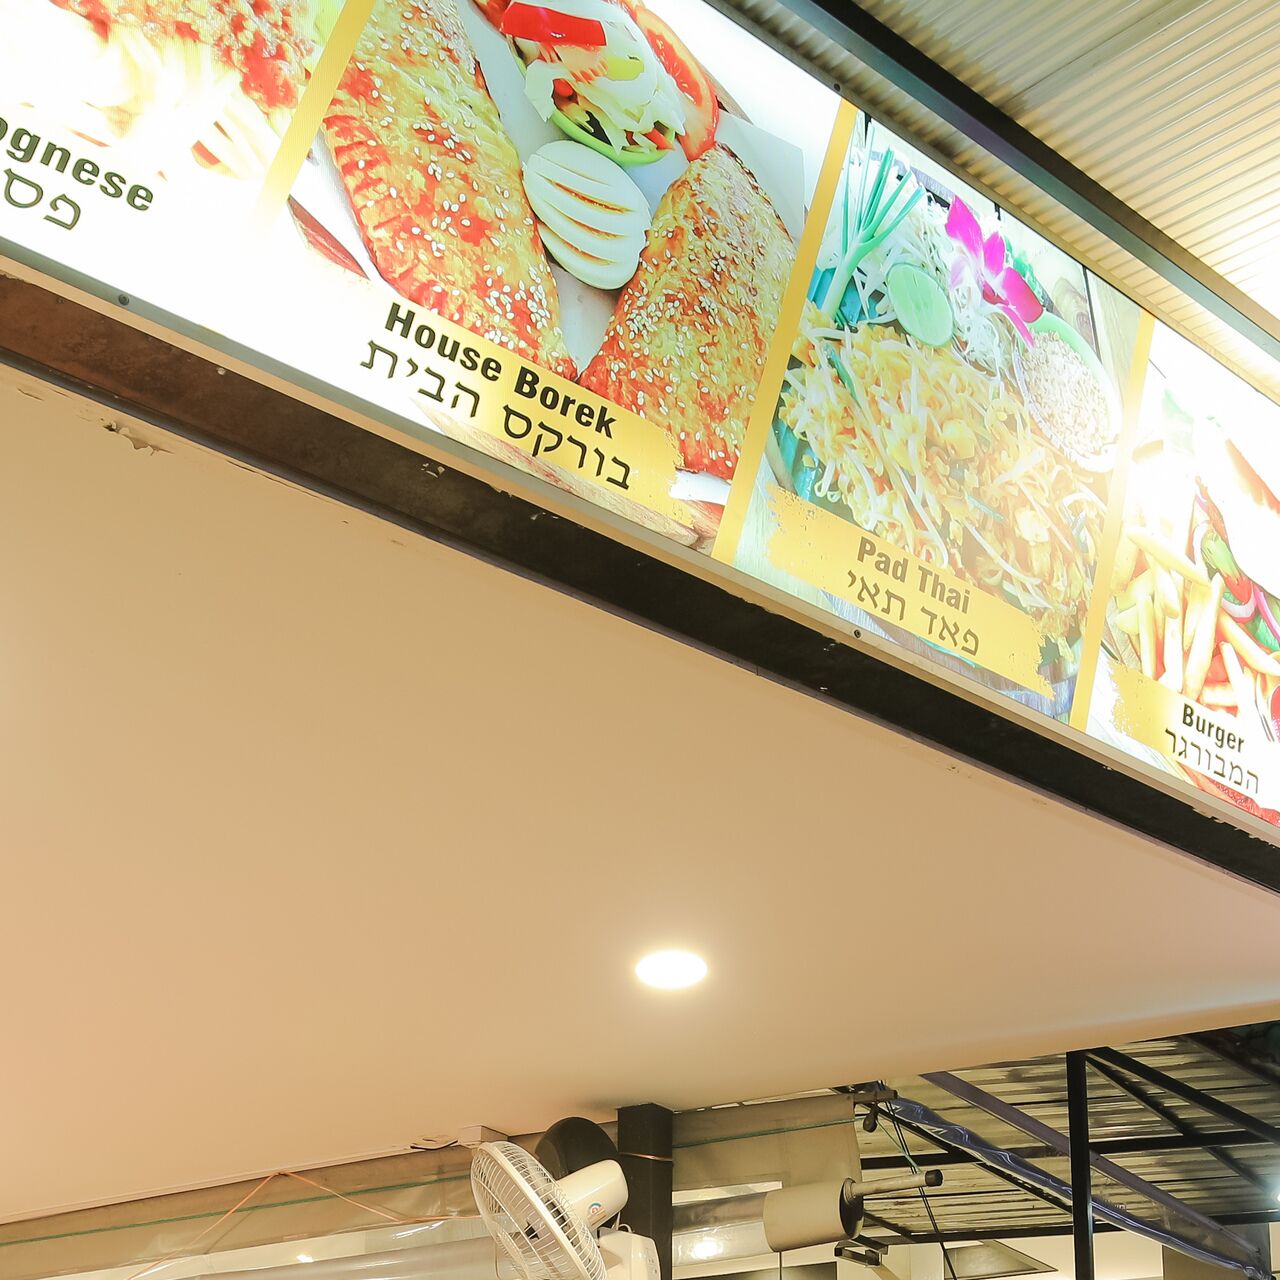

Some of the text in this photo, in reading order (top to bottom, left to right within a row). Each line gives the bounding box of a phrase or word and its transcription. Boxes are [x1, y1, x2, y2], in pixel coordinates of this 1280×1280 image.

[384, 302, 617, 439] House Borek
[360, 341, 631, 490] בורקס הבית
[847, 569, 979, 656] פאד תאי
[857, 536, 970, 614] Pad Thai
[1165, 728, 1259, 794] המבורגר
[1182, 703, 1245, 753] Burger
